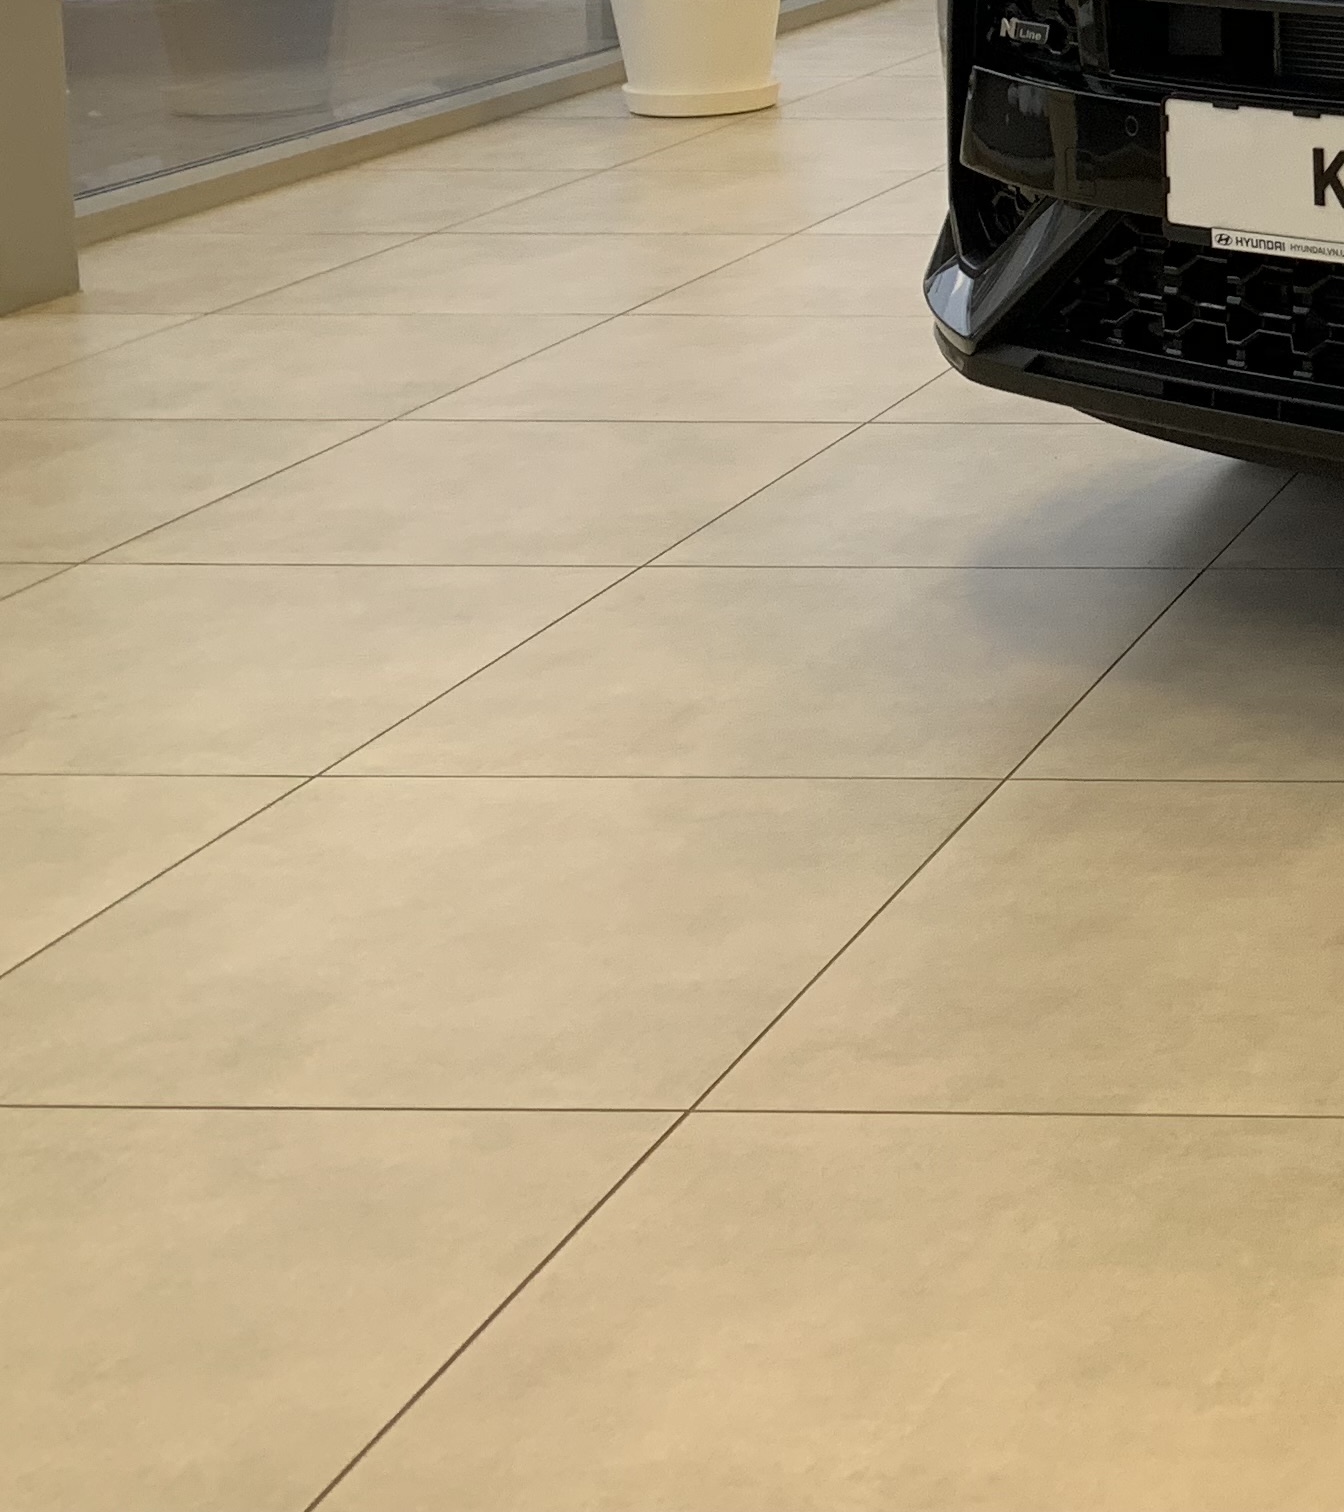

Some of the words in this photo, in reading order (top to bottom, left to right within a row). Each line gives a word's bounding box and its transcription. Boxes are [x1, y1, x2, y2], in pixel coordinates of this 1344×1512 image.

[1000, 17, 1017, 39] N
[1019, 28, 1042, 41] Line
[1235, 236, 1286, 252] HYUNDAI
